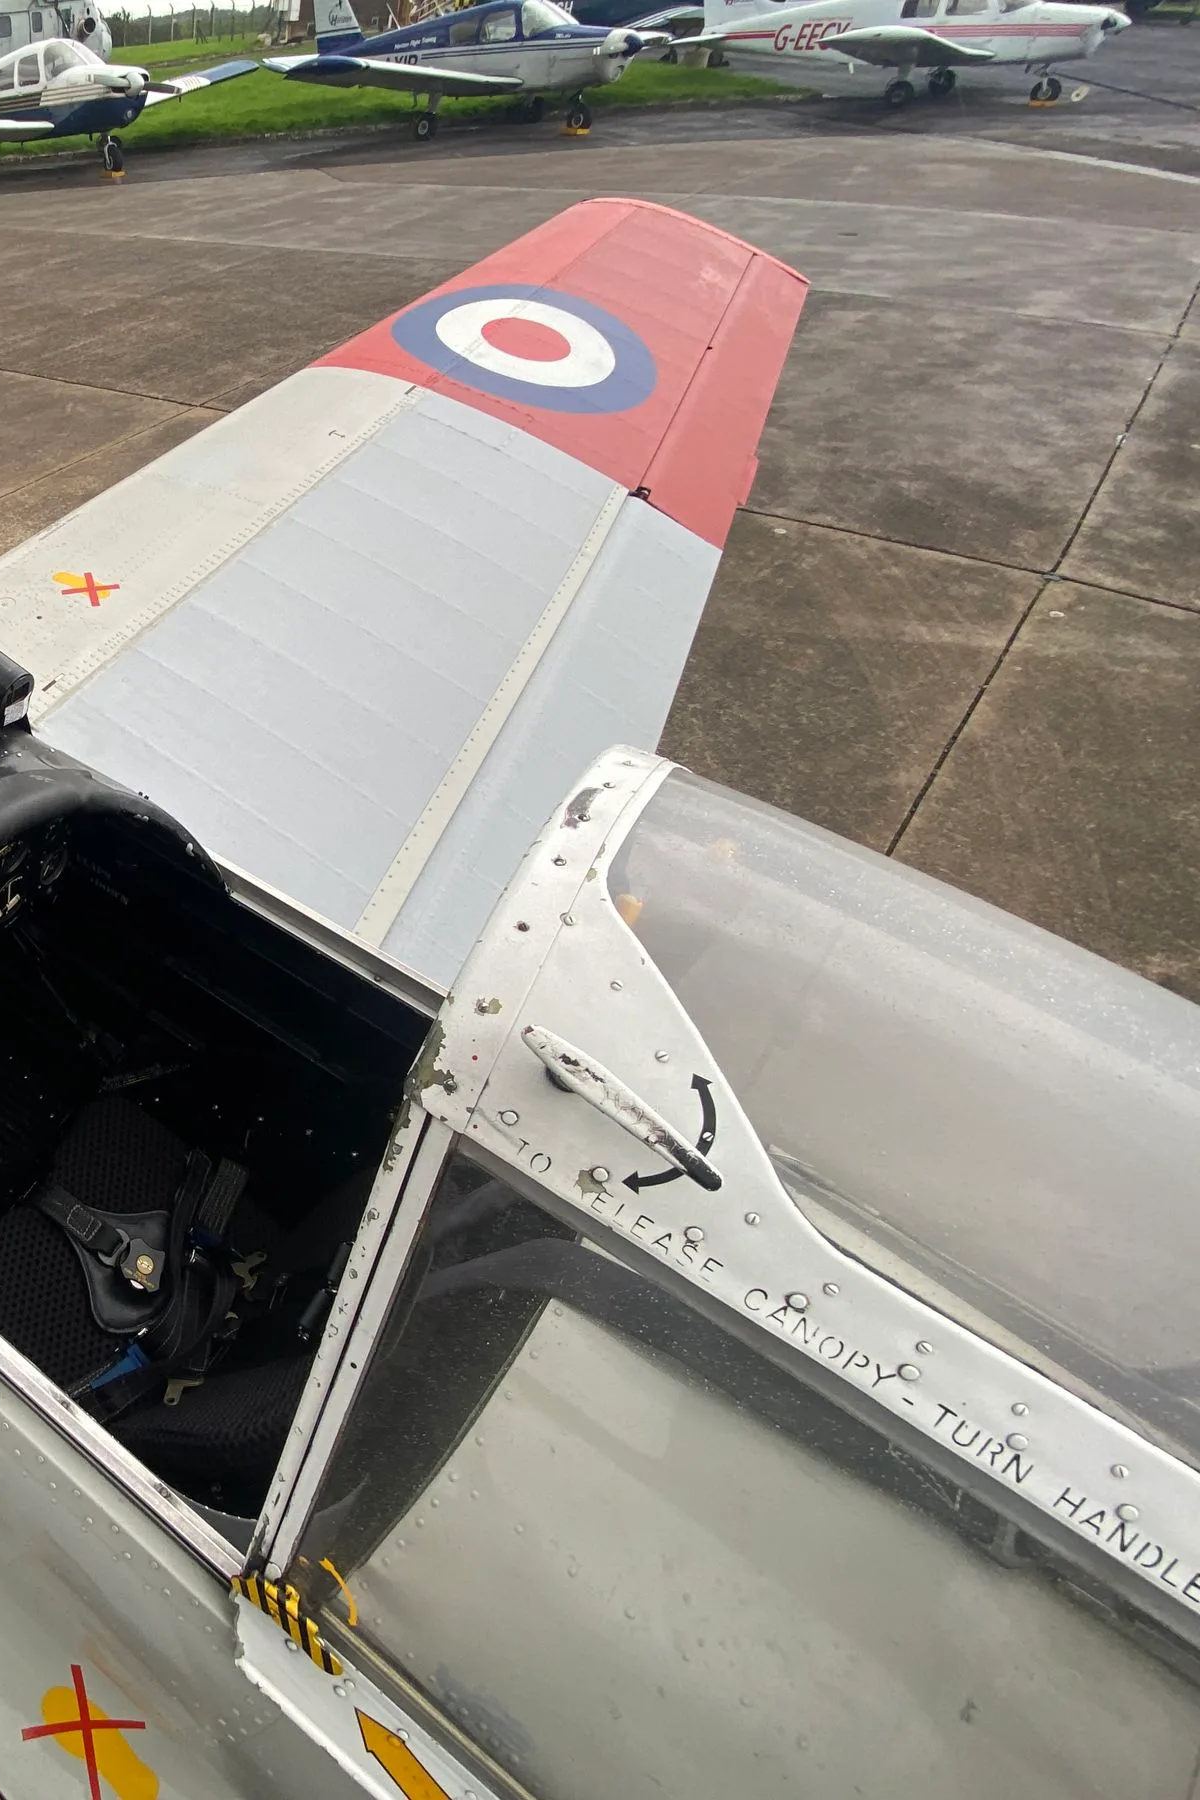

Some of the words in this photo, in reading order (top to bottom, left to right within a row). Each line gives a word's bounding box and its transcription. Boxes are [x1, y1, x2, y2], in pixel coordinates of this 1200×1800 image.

[517, 1138, 551, 1173] TO
[575, 1176, 724, 1282] ELEASE
[744, 1288, 897, 1388] CANOPY
[933, 1403, 1034, 1484] TURN
[1053, 1487, 1200, 1603] HANDLE
